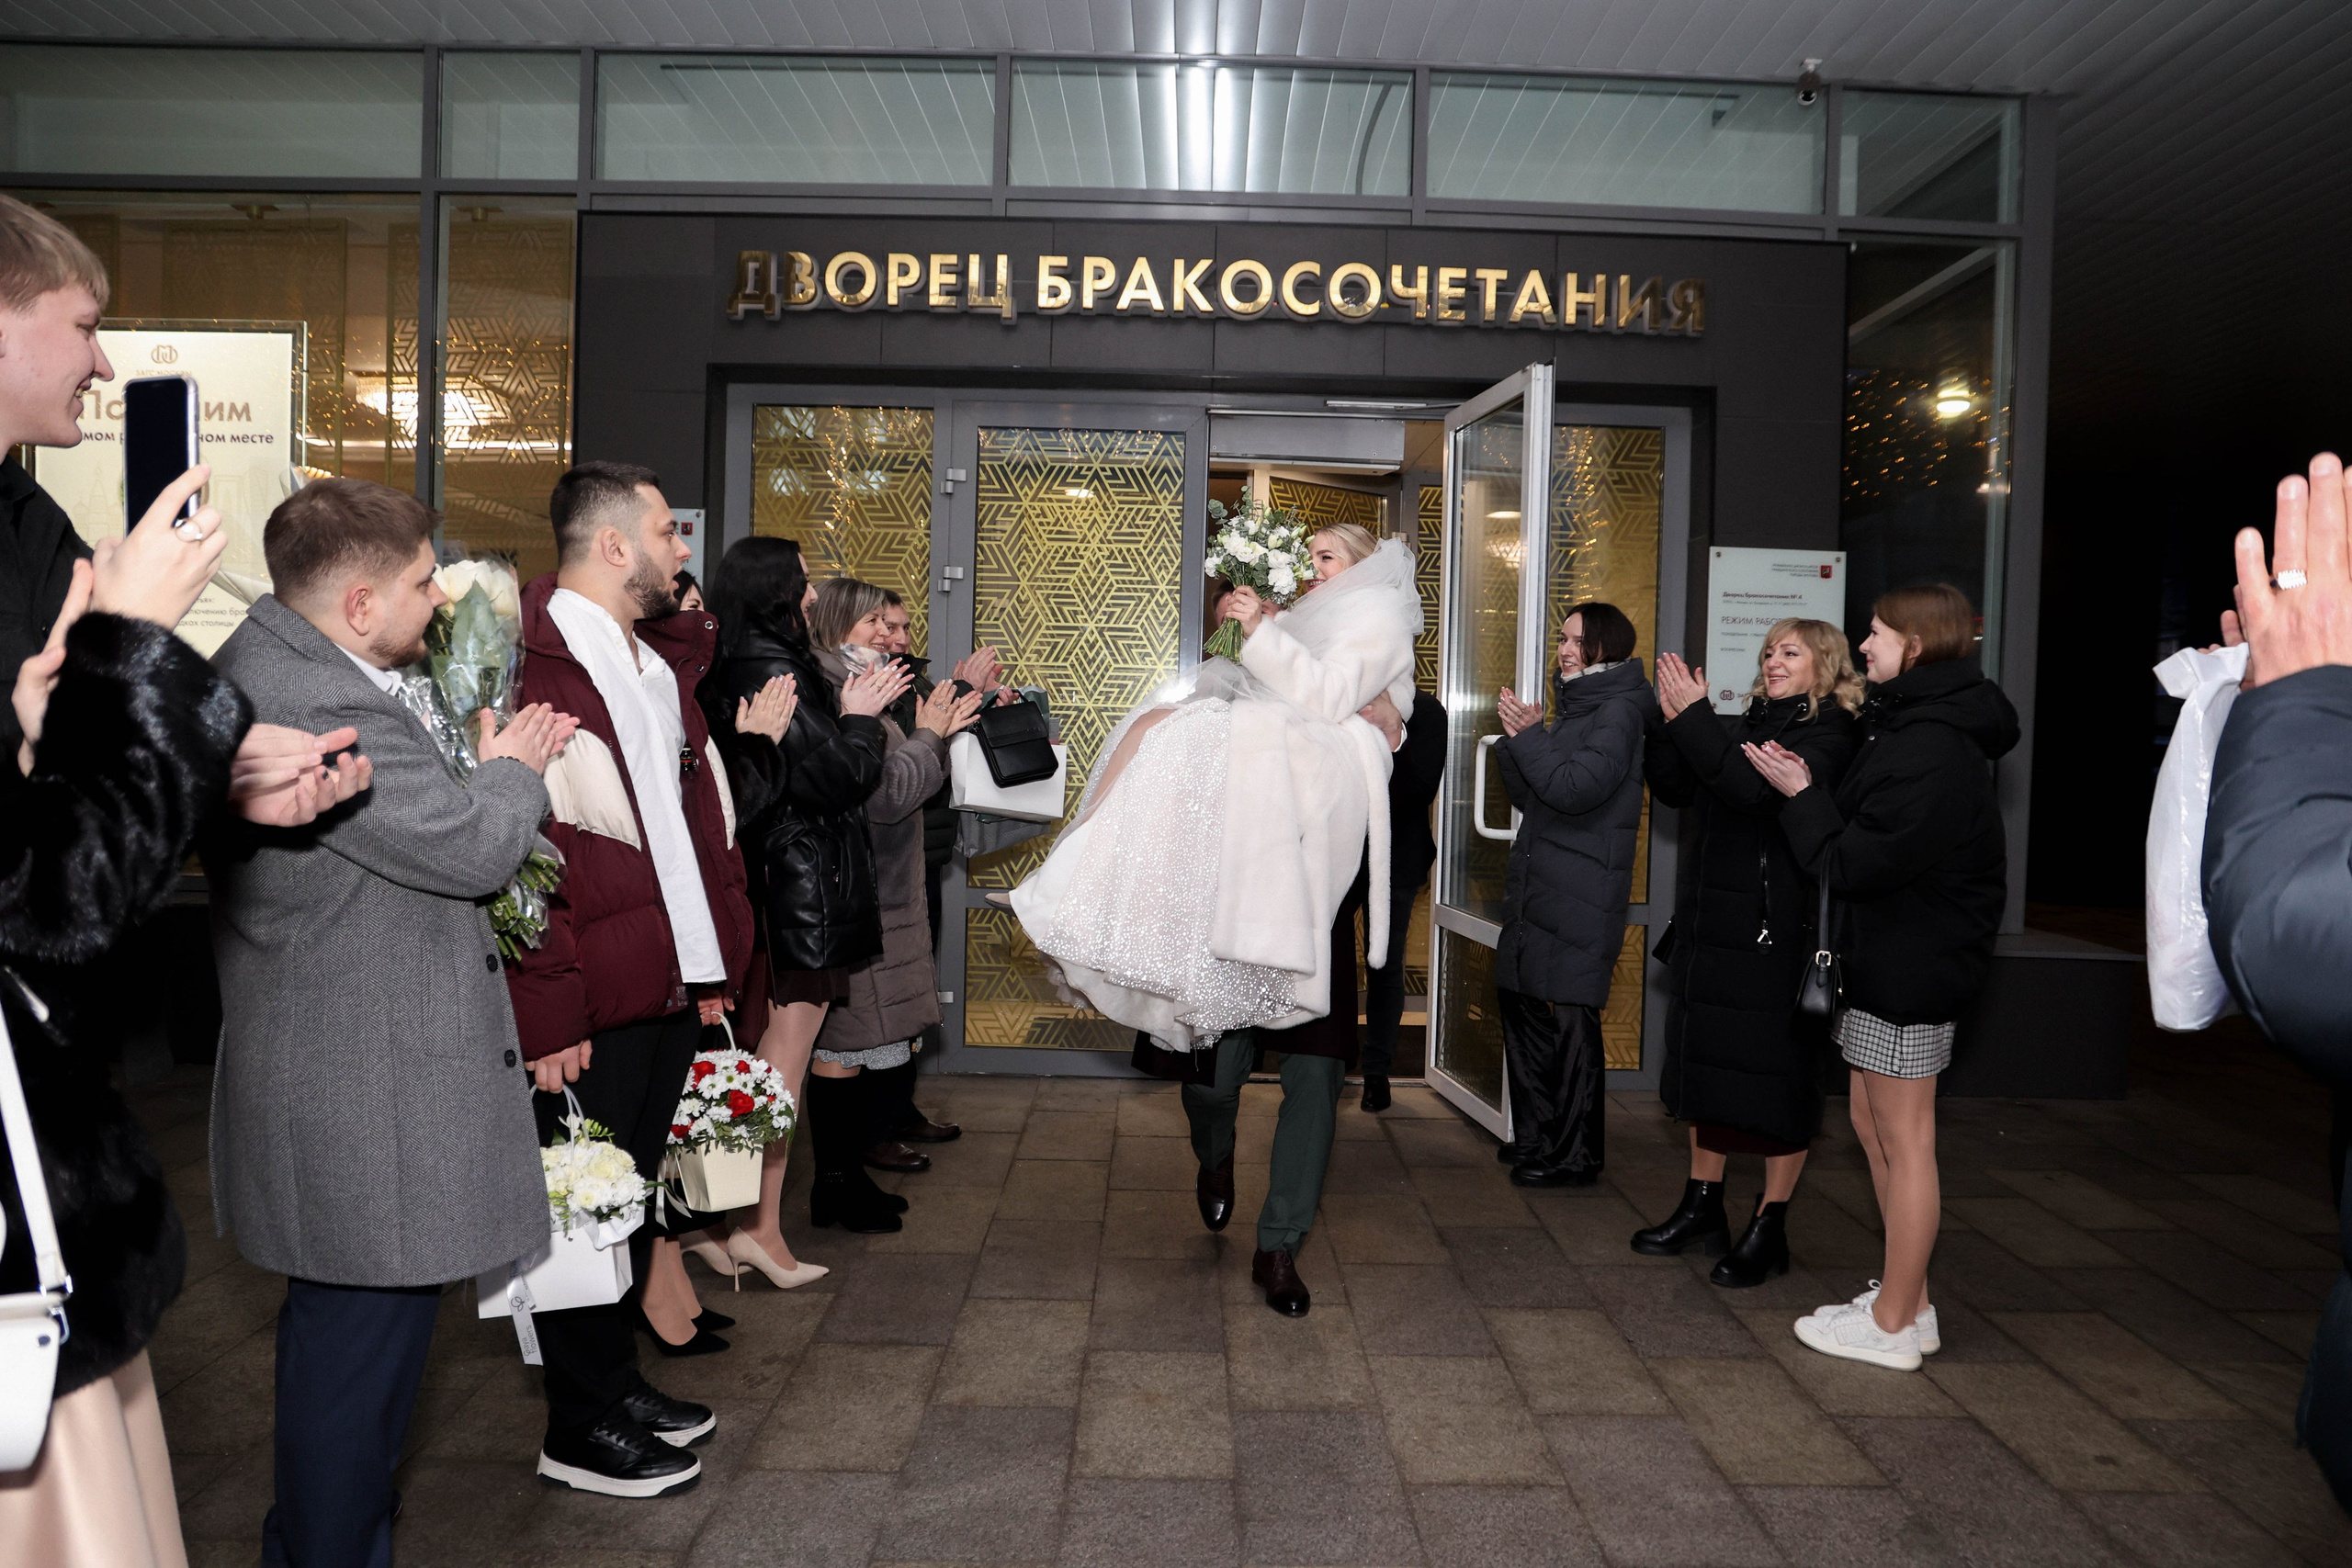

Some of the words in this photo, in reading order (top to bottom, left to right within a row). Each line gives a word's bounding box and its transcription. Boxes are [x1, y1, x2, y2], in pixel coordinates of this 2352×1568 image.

[727, 251, 1013, 320] ДВОРЕЦ
[1037, 254, 1706, 333] БРАКОСОЧЕТАНИЯ
[230, 434, 275, 445] месте
[1721, 615, 1754, 626] РЕЖИМ
